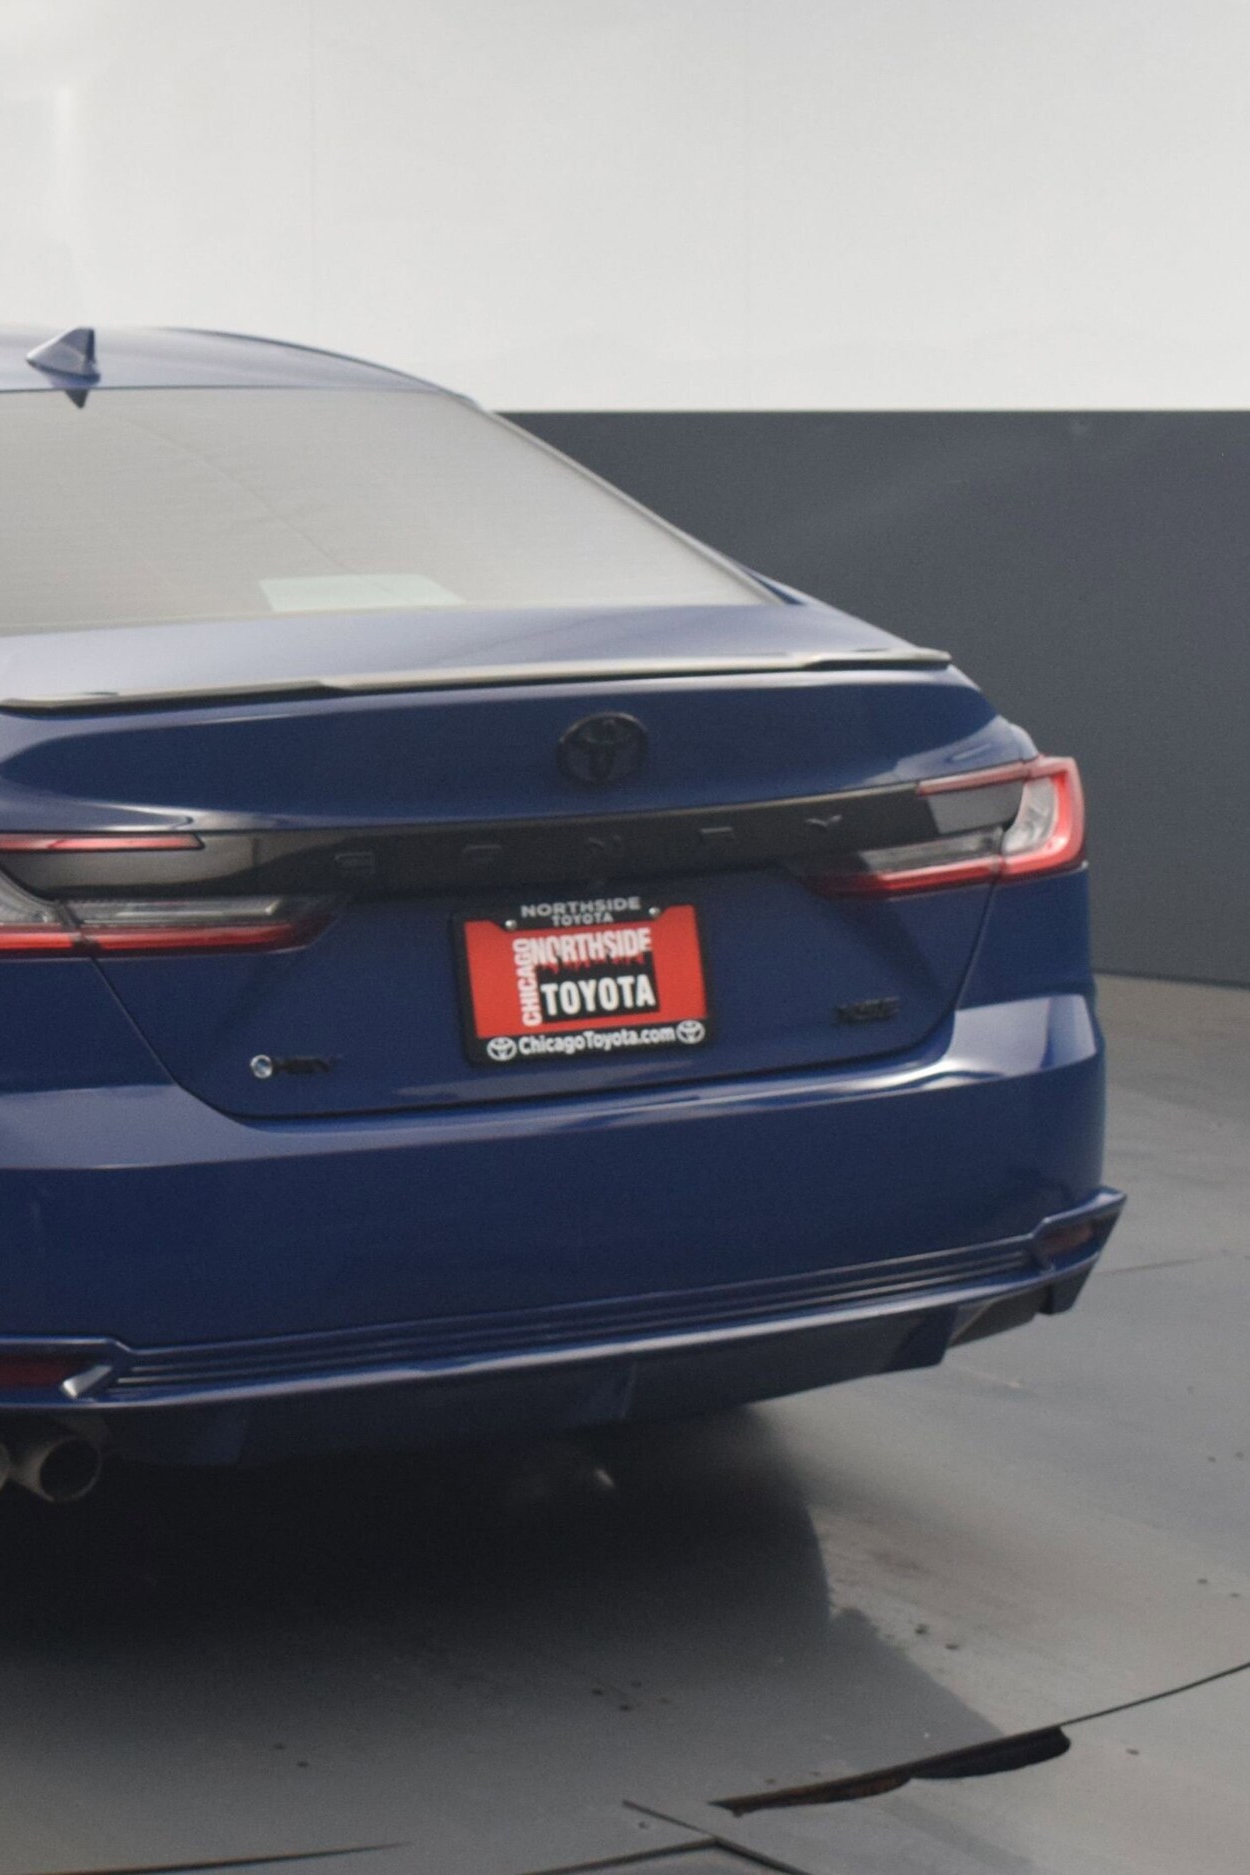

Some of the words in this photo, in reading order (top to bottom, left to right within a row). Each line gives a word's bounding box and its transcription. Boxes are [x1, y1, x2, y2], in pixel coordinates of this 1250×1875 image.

[520, 896, 641, 918] NORTHSIDE
[552, 912, 614, 928] TOYOTA
[528, 927, 652, 967] NORTHSIDE
[512, 937, 543, 1027] CHICAGO
[540, 974, 656, 1017] TOYOTA
[518, 1026, 676, 1055] ChicagoToyota.com
